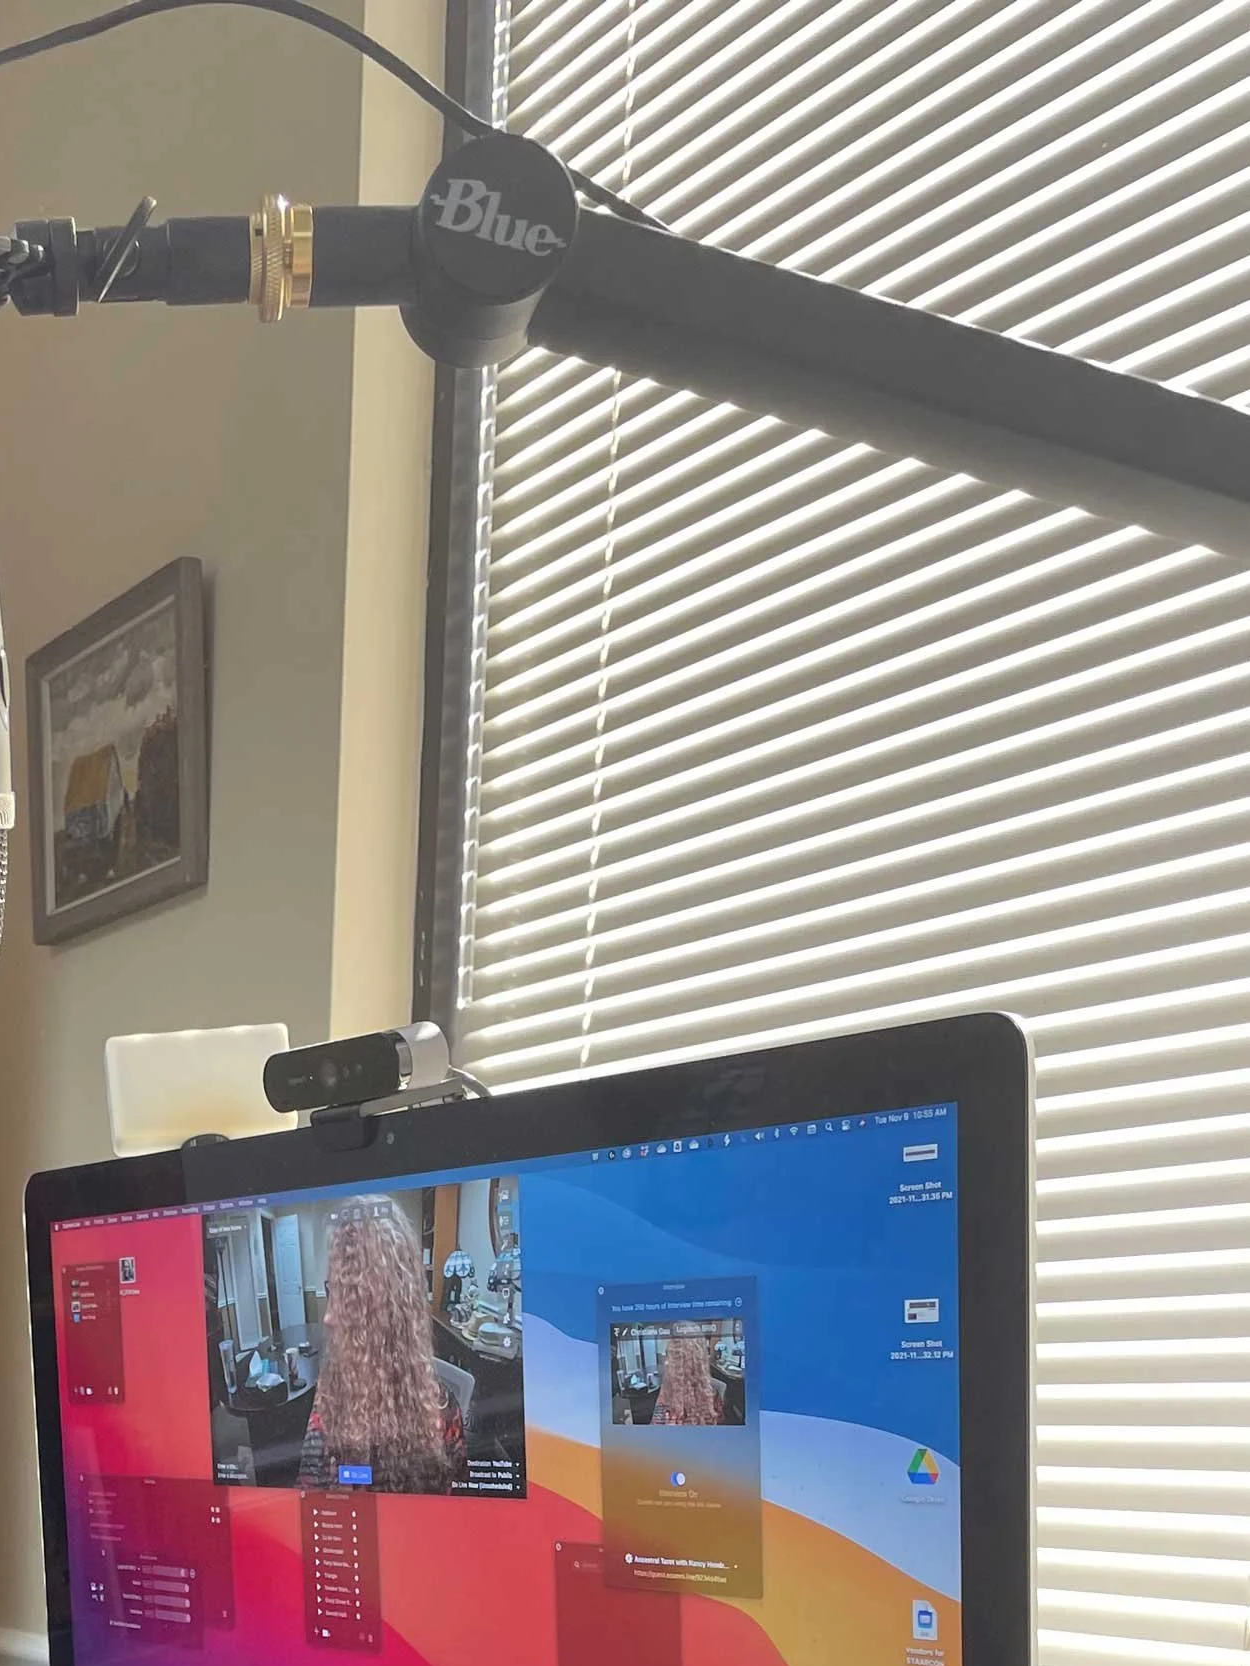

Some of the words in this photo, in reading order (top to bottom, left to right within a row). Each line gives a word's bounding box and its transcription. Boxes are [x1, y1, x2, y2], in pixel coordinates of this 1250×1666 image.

[430, 179, 567, 256] Blue
[874, 1116, 887, 1125] Tue
[888, 1114, 902, 1122] Nov
[903, 1112, 909, 1121] 9
[934, 1108, 947, 1116] AM
[899, 1183, 924, 1192] Screen
[925, 1181, 942, 1189] Shot
[941, 1191, 953, 1200] PM
[901, 1340, 925, 1348] Screen
